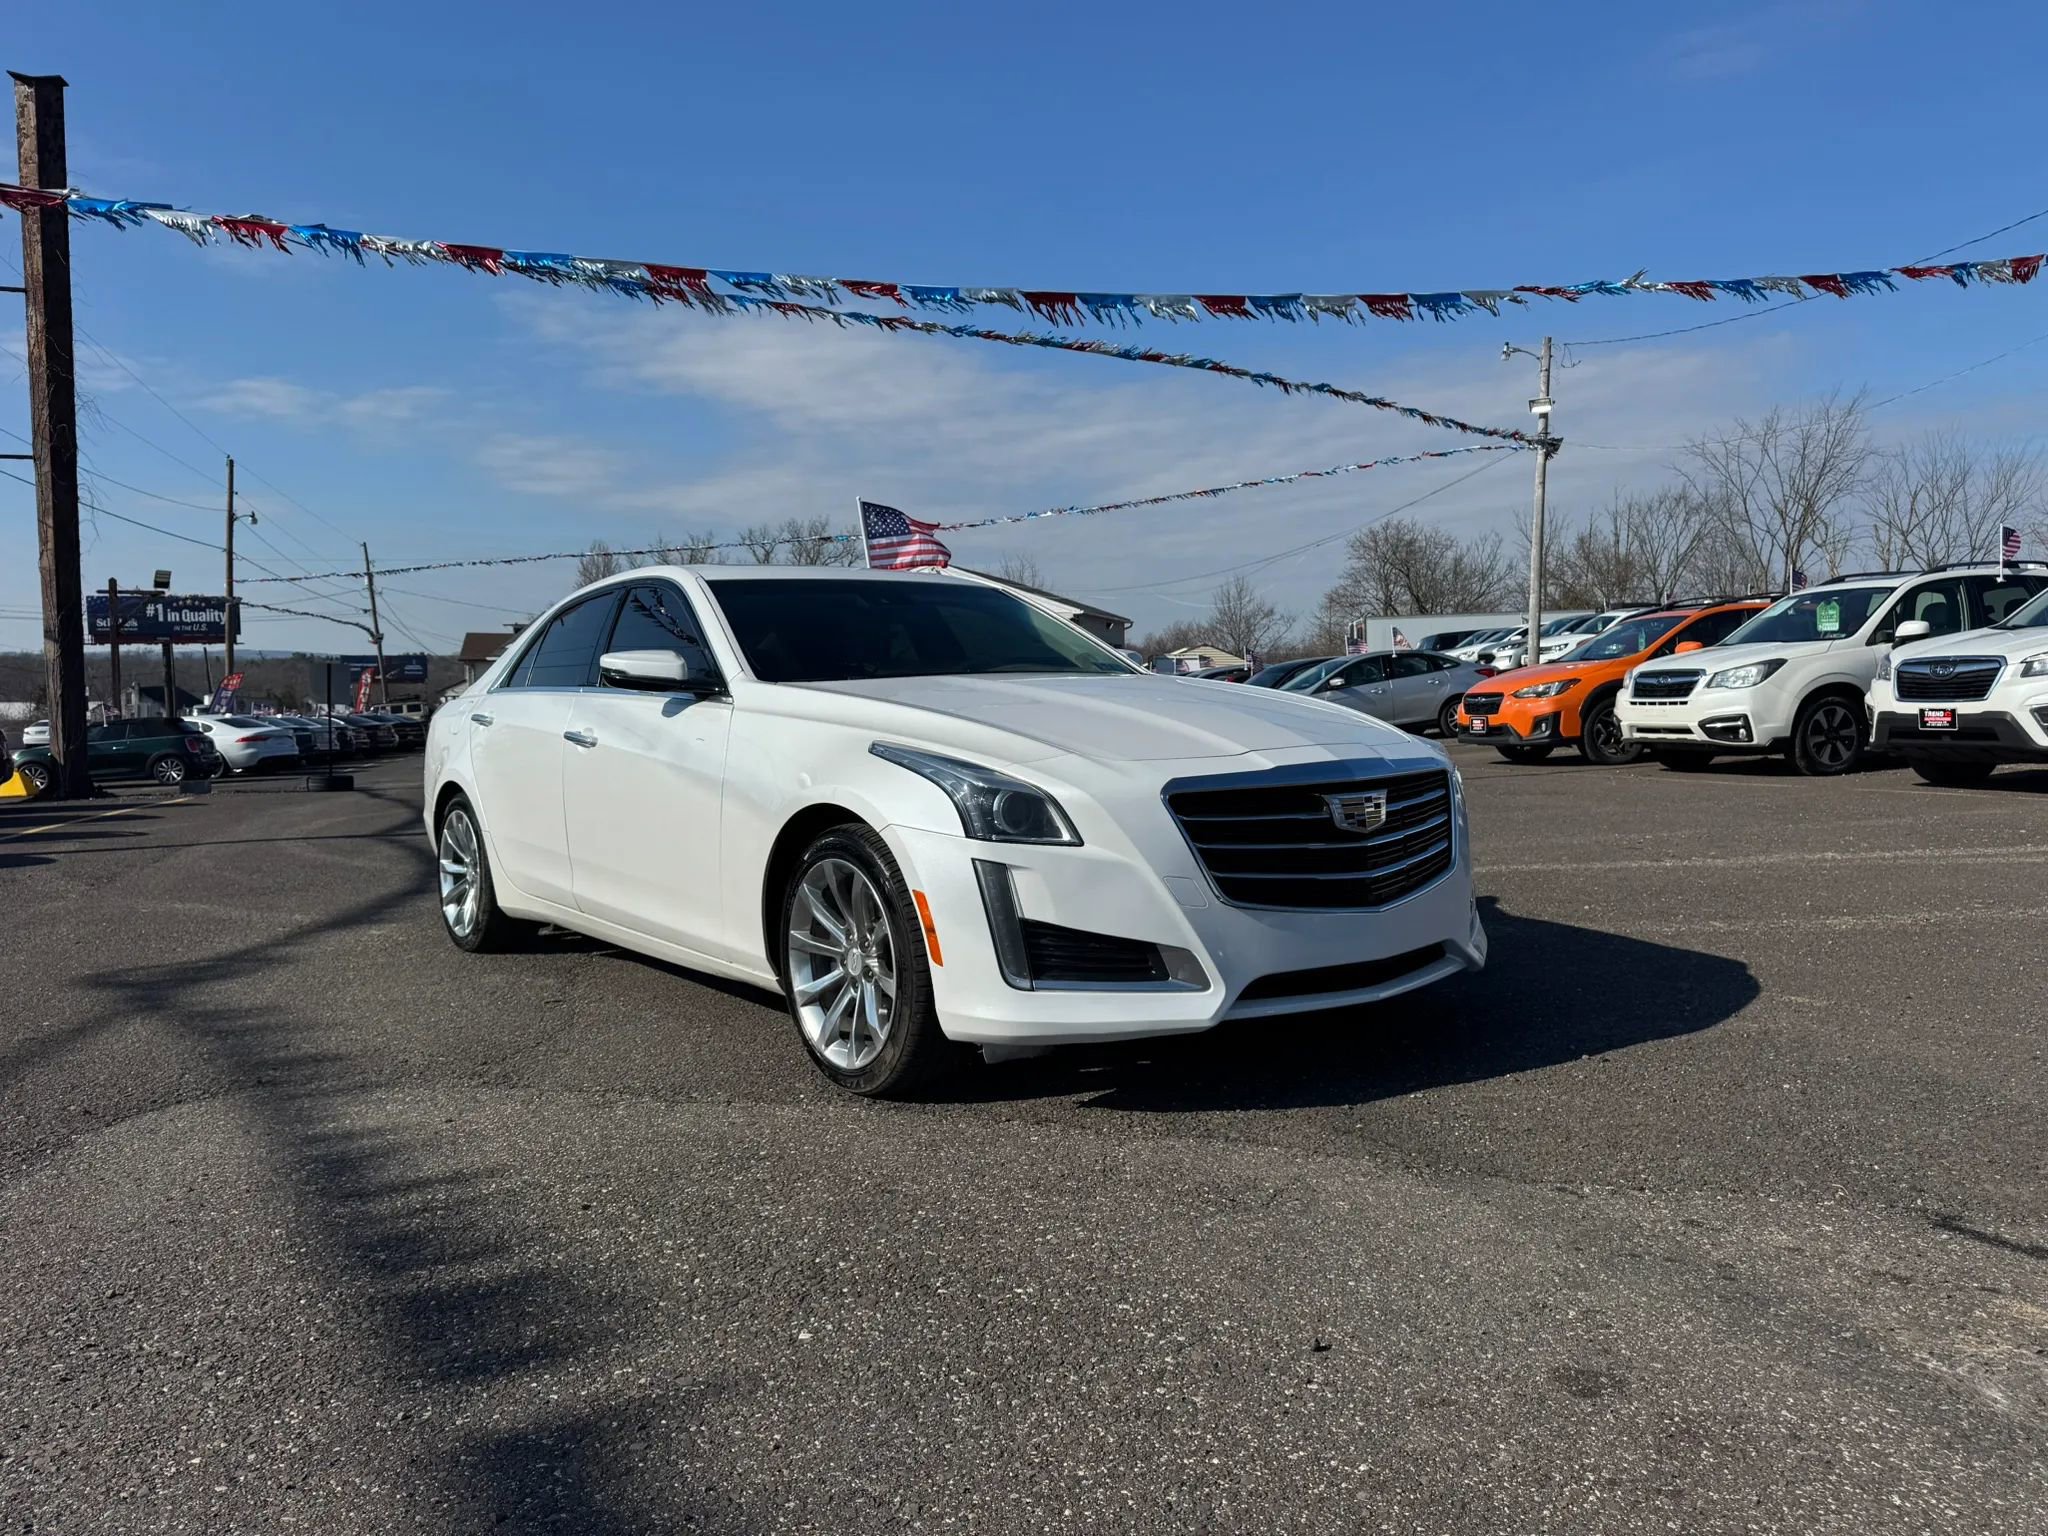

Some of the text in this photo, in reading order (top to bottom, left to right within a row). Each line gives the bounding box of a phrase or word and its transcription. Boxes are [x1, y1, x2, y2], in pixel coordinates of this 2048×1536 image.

[146, 603, 226, 625] #1 in Quality
[193, 623, 208, 631] U.S.
